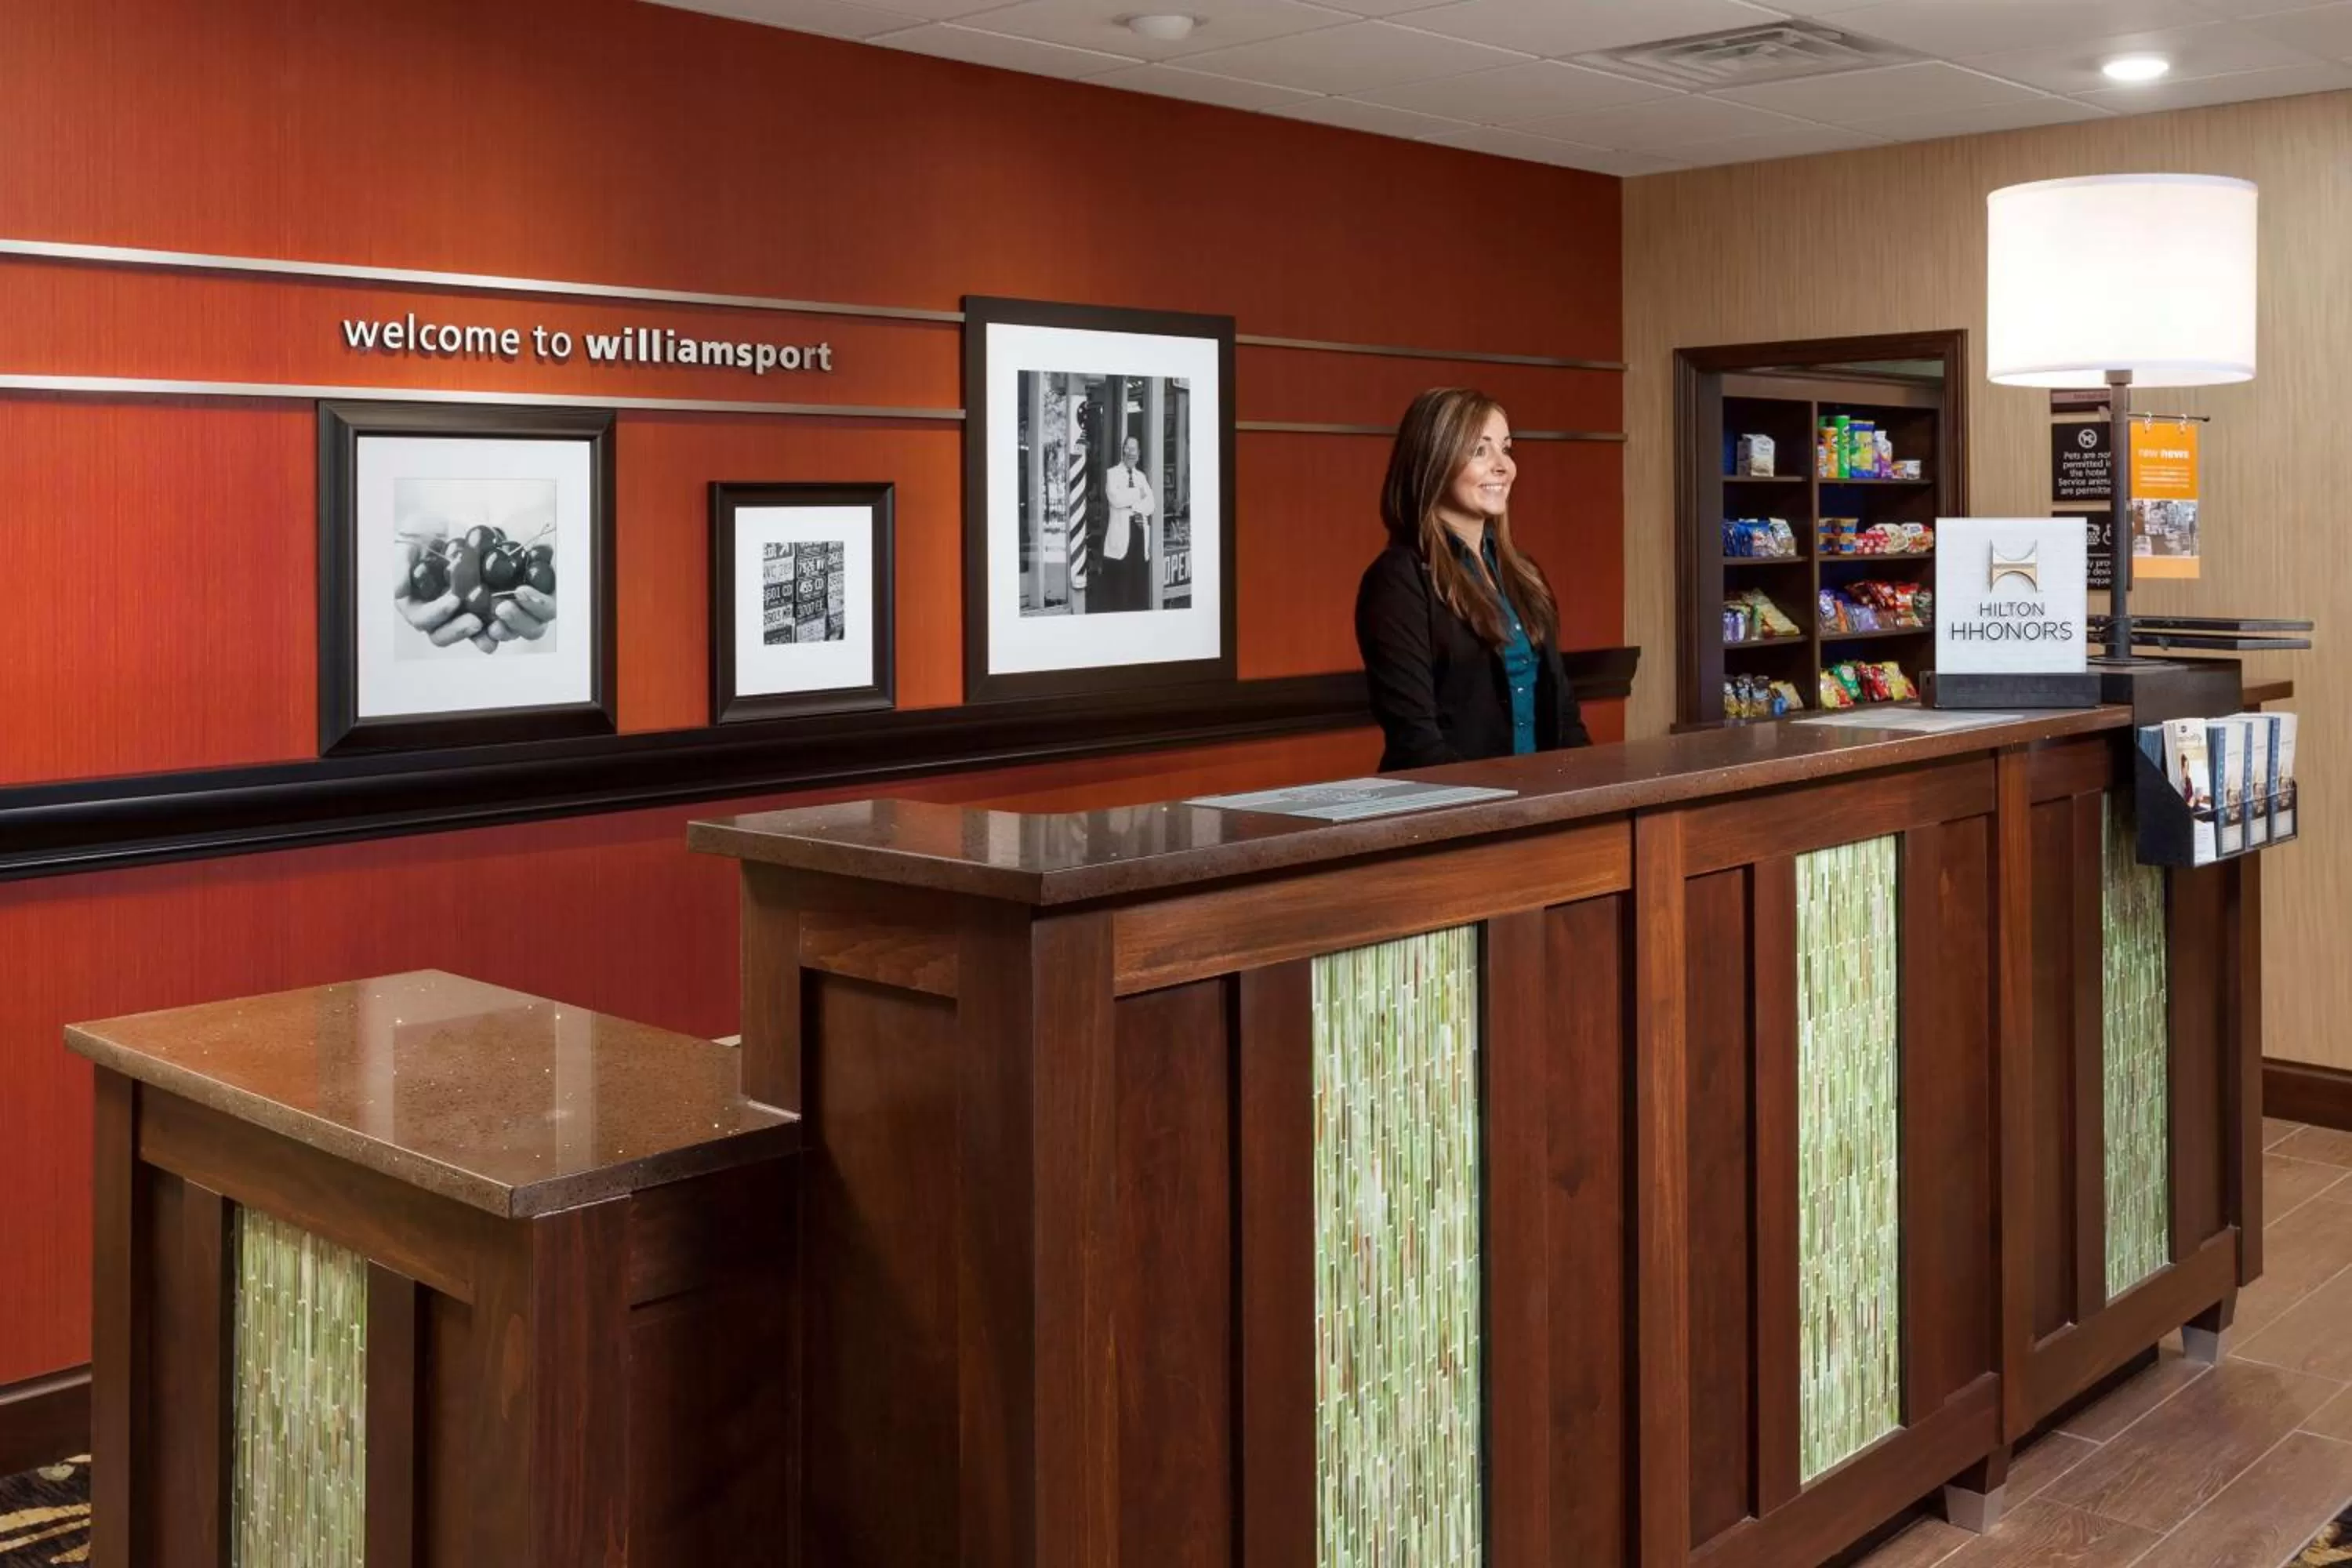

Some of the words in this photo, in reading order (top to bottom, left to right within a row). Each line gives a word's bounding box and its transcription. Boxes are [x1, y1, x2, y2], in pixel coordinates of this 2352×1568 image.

[343, 313, 520, 355] welcome
[532, 318, 572, 357] to
[586, 327, 832, 375] williamsport
[2063, 451, 2081, 460] Pets
[2063, 459, 2103, 470] permitted
[2070, 469, 2084, 477] the
[2085, 468, 2107, 477] hotel
[2058, 477, 2086, 487] Service
[2075, 486, 2111, 496] permitte
[1979, 601, 2045, 618] HILTON
[1951, 621, 2074, 641] HHONORS
